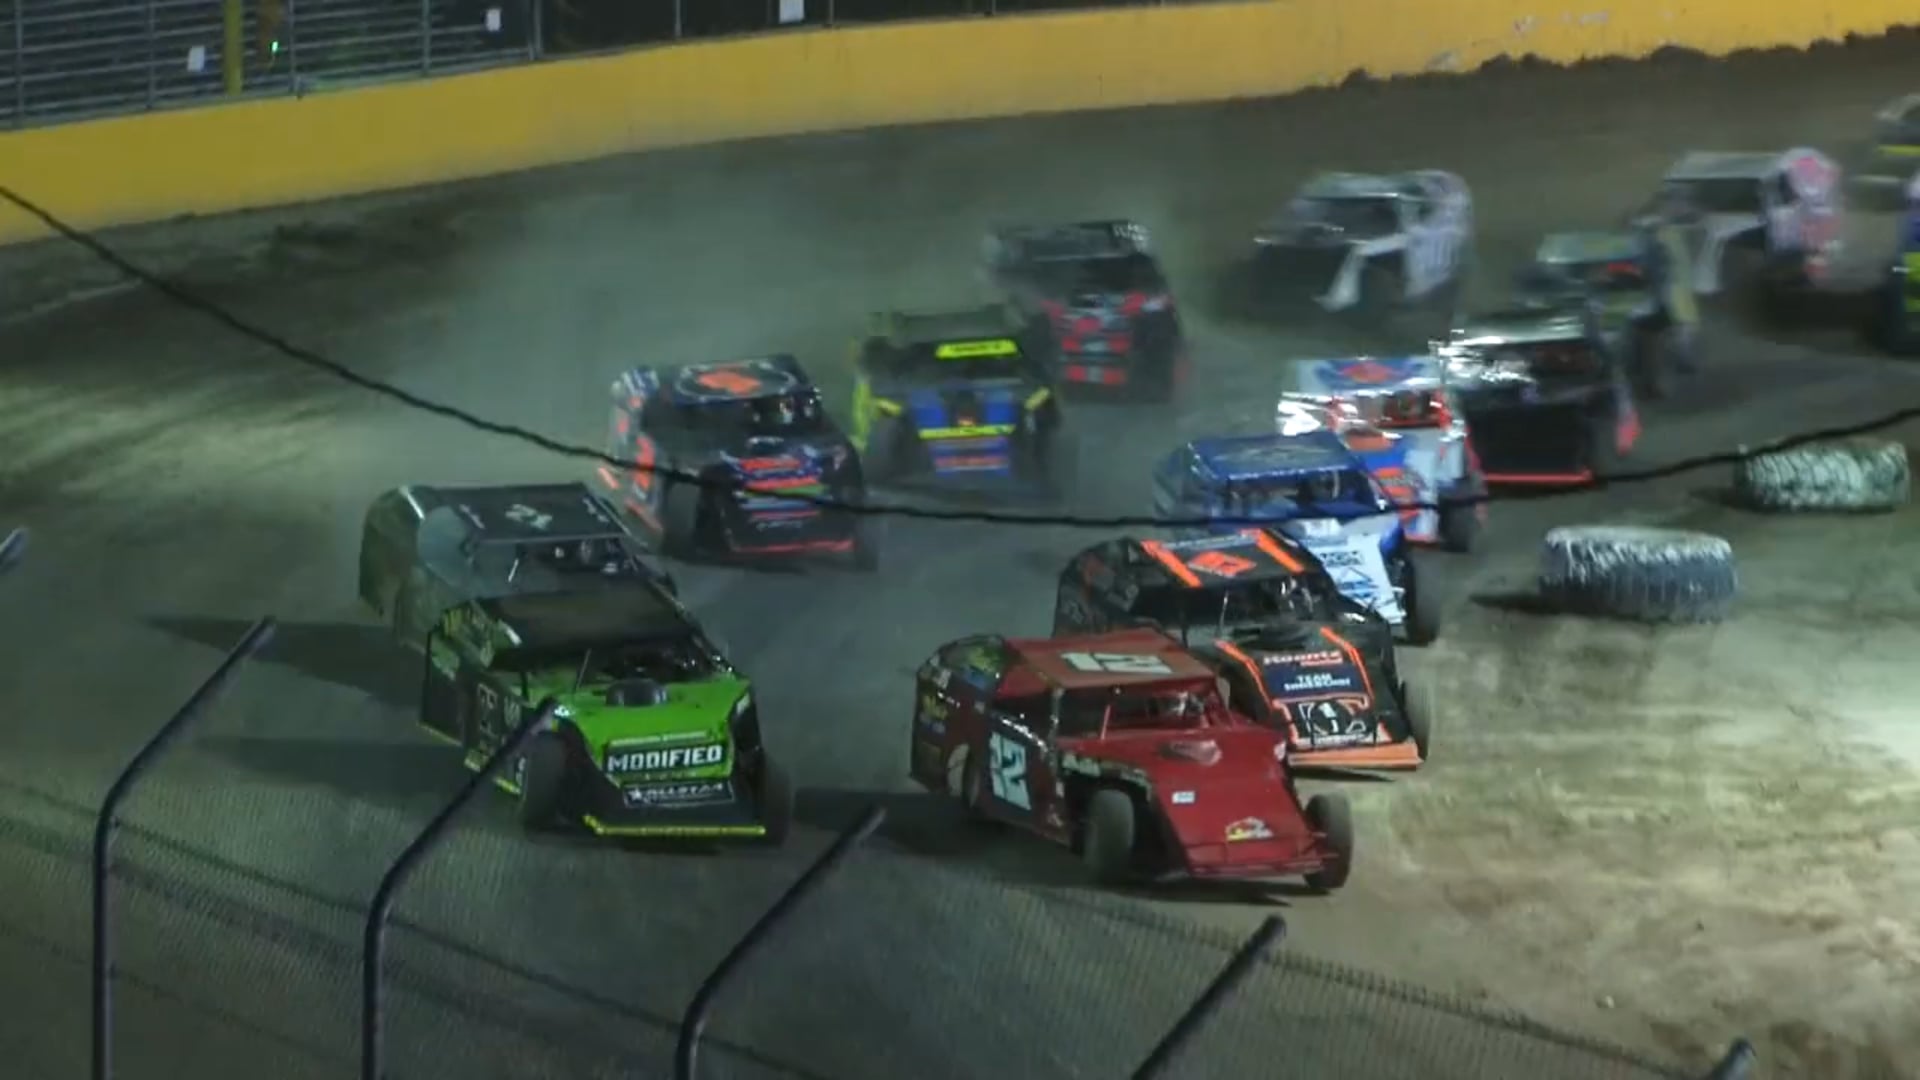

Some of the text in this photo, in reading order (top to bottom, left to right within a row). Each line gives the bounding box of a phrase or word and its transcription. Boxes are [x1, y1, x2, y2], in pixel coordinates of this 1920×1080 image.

[1060, 652, 1173, 674] 12
[1296, 672, 1333, 685] TEAM
[607, 744, 723, 771] MODIFIED
